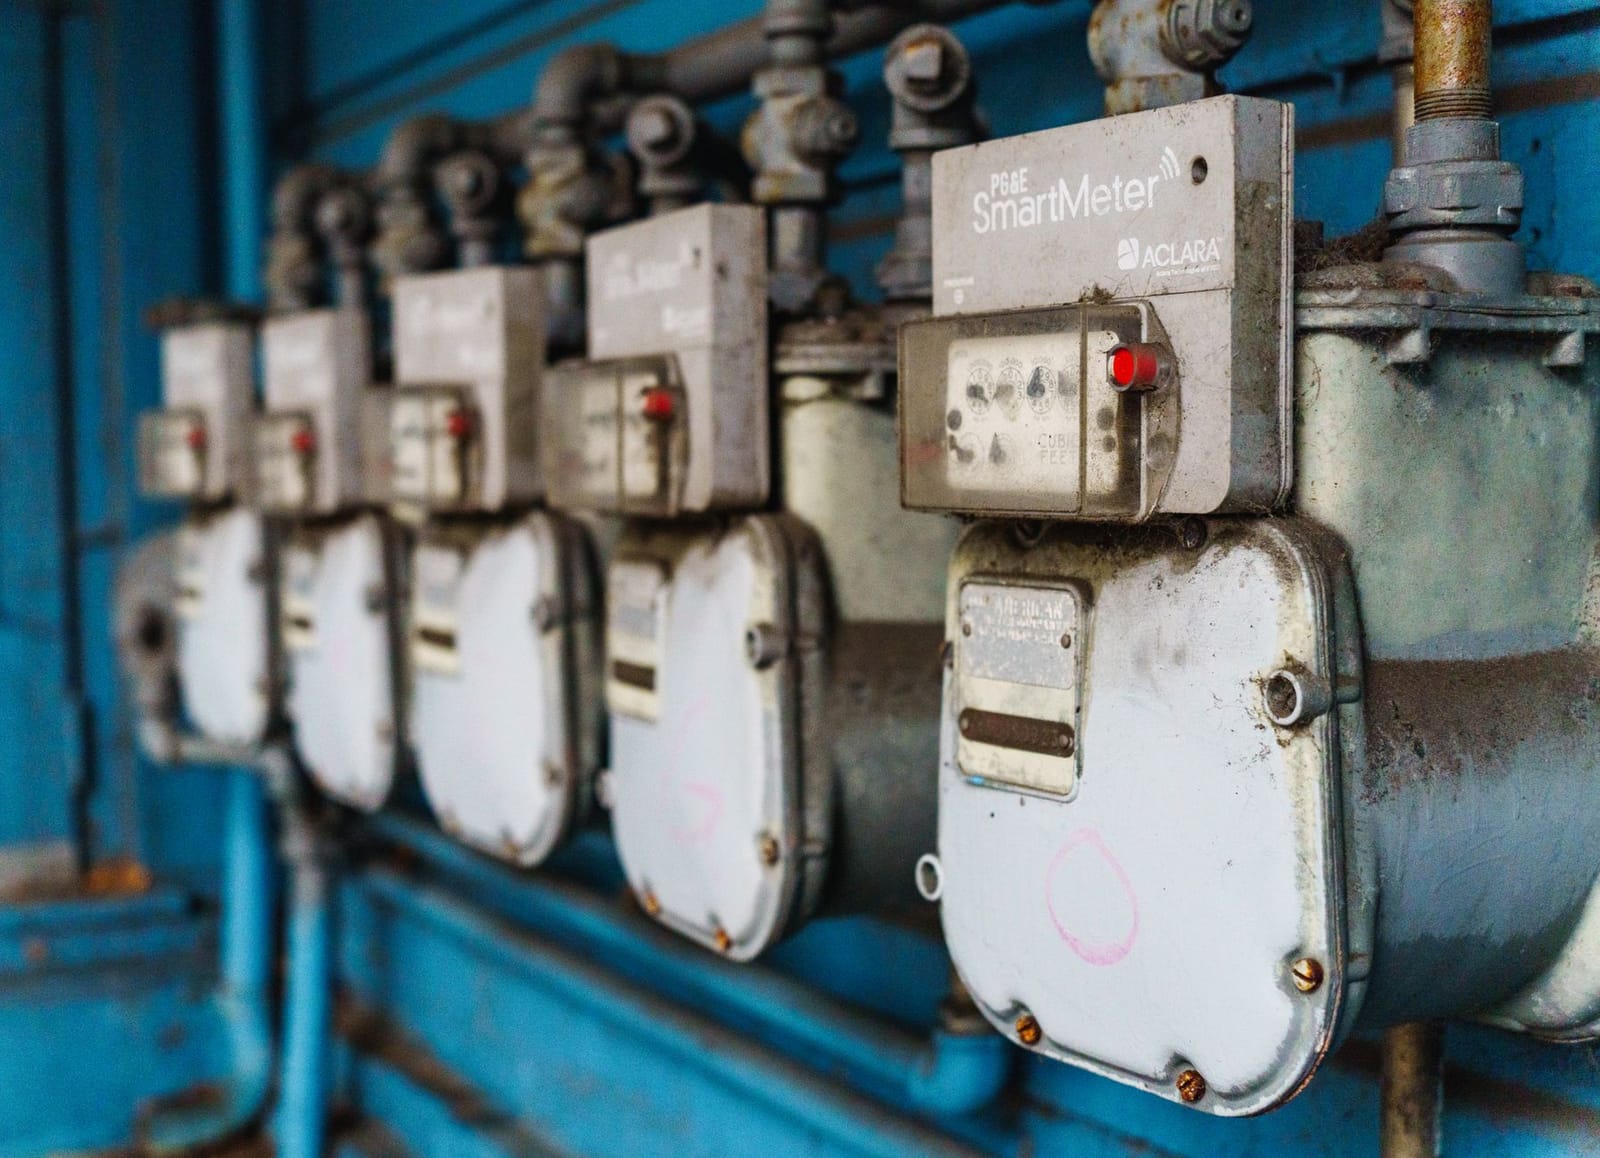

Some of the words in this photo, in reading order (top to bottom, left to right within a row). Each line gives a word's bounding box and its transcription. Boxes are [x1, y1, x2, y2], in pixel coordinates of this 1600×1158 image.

[991, 167, 1028, 198] PG&E
[972, 173, 1159, 234] SmartMeter
[1141, 237, 1220, 269] ACLARA
